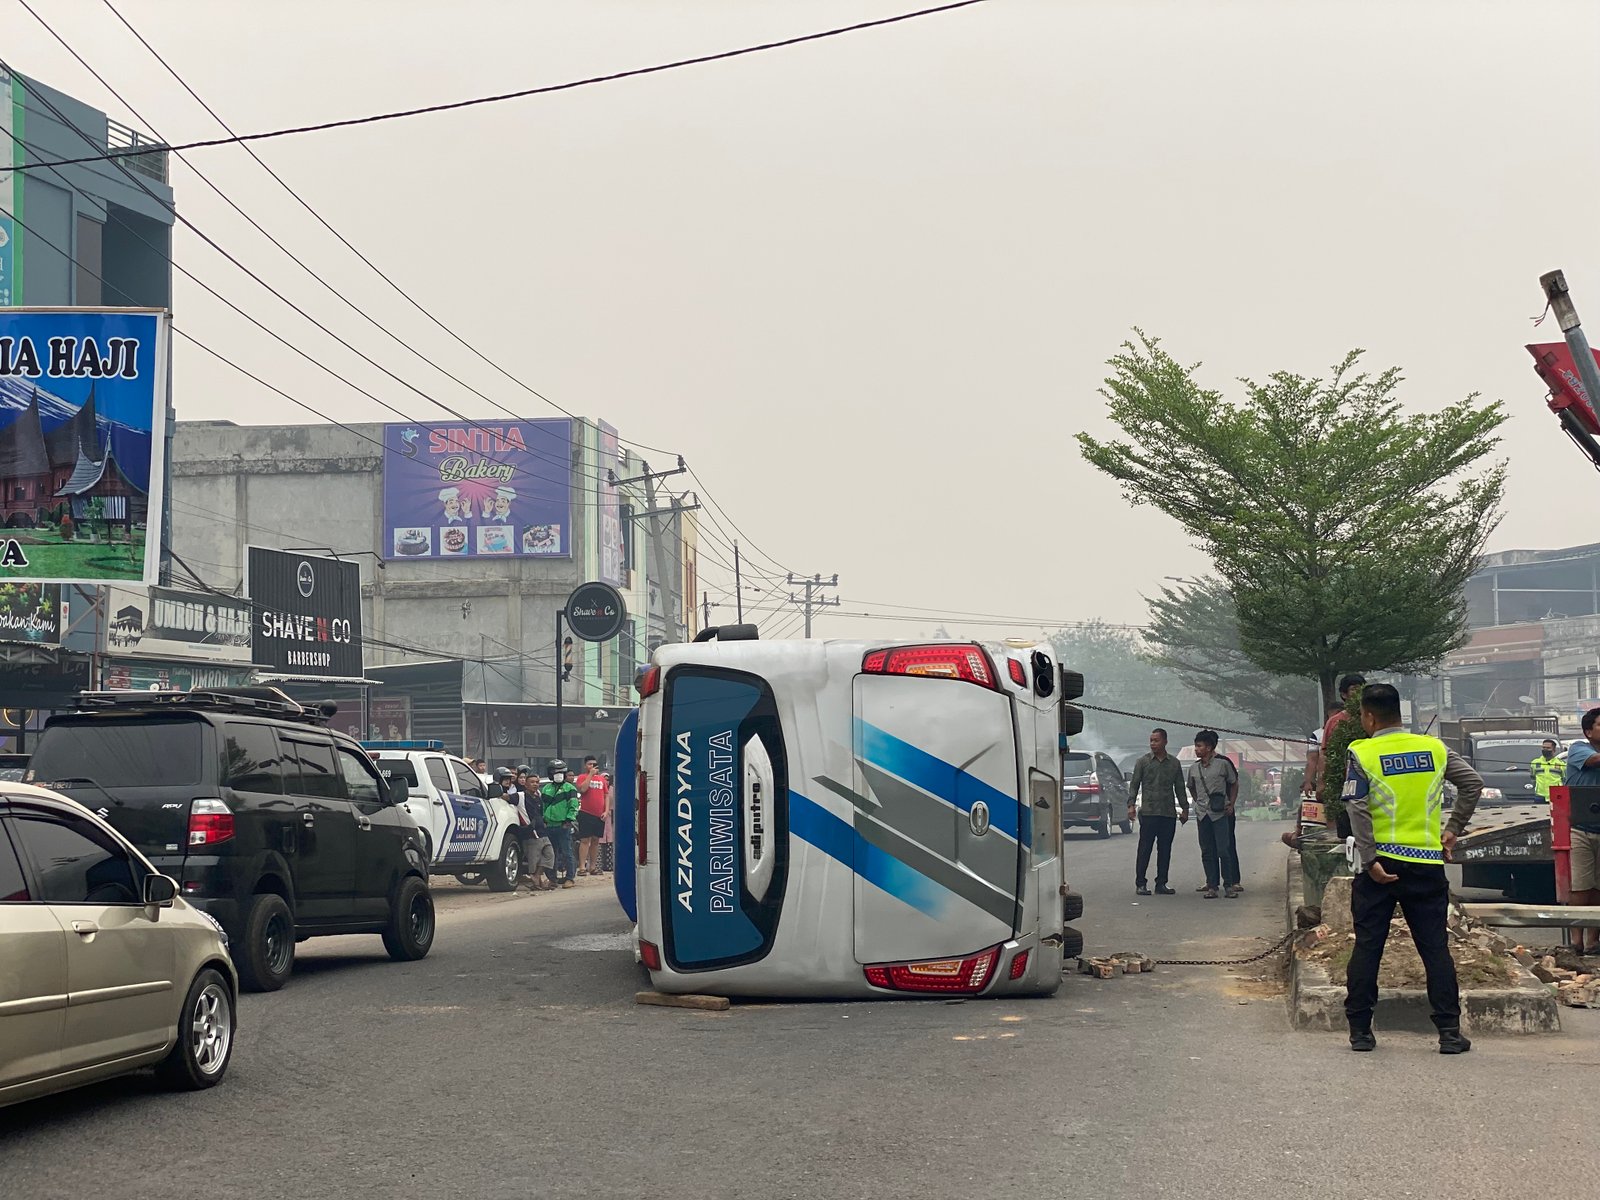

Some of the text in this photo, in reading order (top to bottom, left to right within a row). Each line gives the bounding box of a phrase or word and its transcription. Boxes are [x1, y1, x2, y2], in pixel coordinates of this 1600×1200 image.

[47, 336, 140, 379] HAJI
[429, 427, 527, 453] SINTIA
[439, 456, 517, 482] Bakery
[30, 606, 55, 633] Kami
[154, 600, 251, 635] UMROH & HAJI
[262, 612, 351, 643] SHAVE N CO
[287, 650, 331, 667] BARBERSHOP
[1382, 754, 1433, 772] POLISI
[456, 817, 477, 831] POLISI
[676, 731, 693, 913] AZKADYNA
[708, 729, 734, 913] PARIWISATA
[750, 782, 764, 860] adiputro
